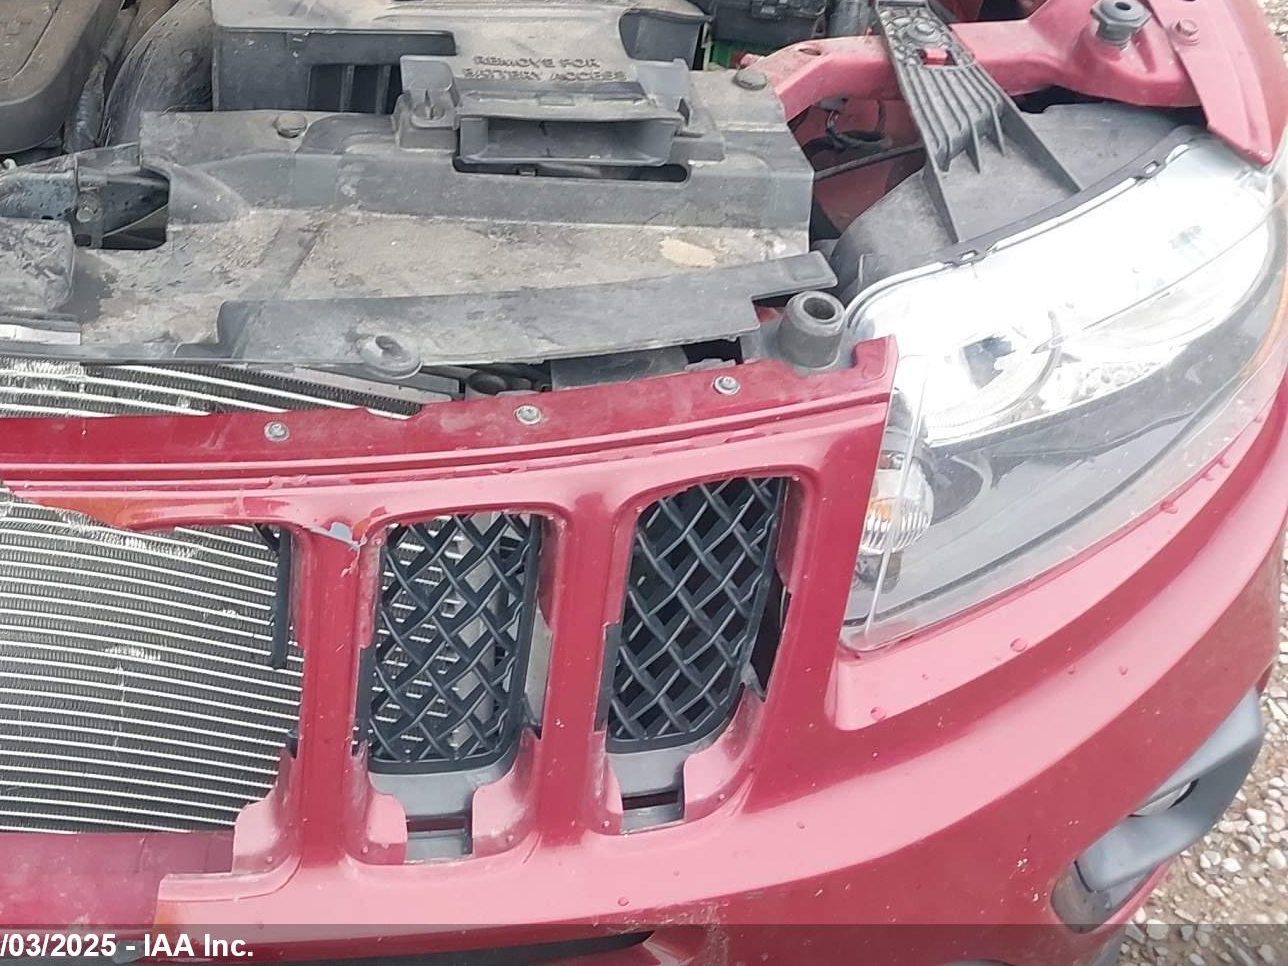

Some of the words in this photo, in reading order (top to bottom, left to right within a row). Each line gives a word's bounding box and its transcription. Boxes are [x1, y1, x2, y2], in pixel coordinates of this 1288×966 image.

[473, 55, 555, 69] REMOVE
[559, 57, 600, 69] FOR
[463, 68, 541, 81] BATTERY
[550, 70, 627, 82] ACCESS
